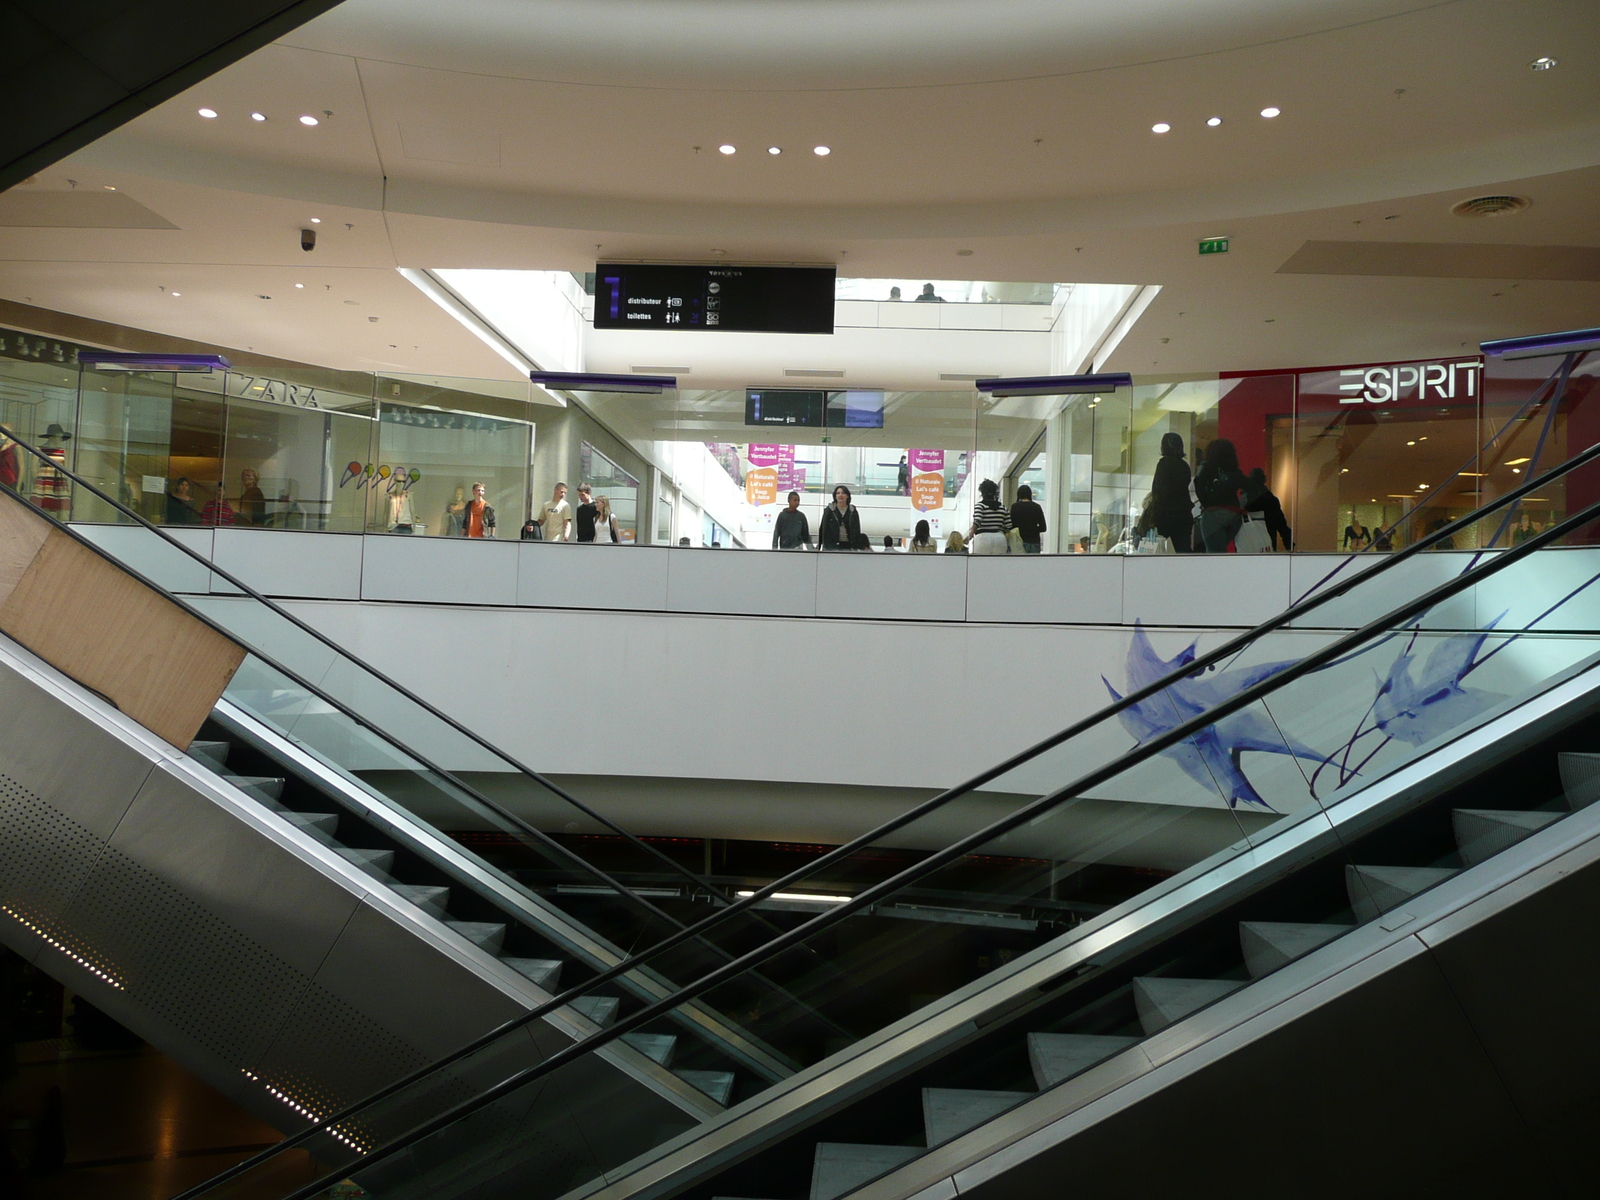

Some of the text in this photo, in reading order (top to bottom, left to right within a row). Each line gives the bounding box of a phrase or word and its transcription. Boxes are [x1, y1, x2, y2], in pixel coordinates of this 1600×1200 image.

[604, 276, 620, 318] 1
[627, 297, 661, 305] distributeur
[627, 312, 651, 320] toilettes
[239, 374, 322, 408] ZARA
[1339, 362, 1484, 404] ESPRIT
